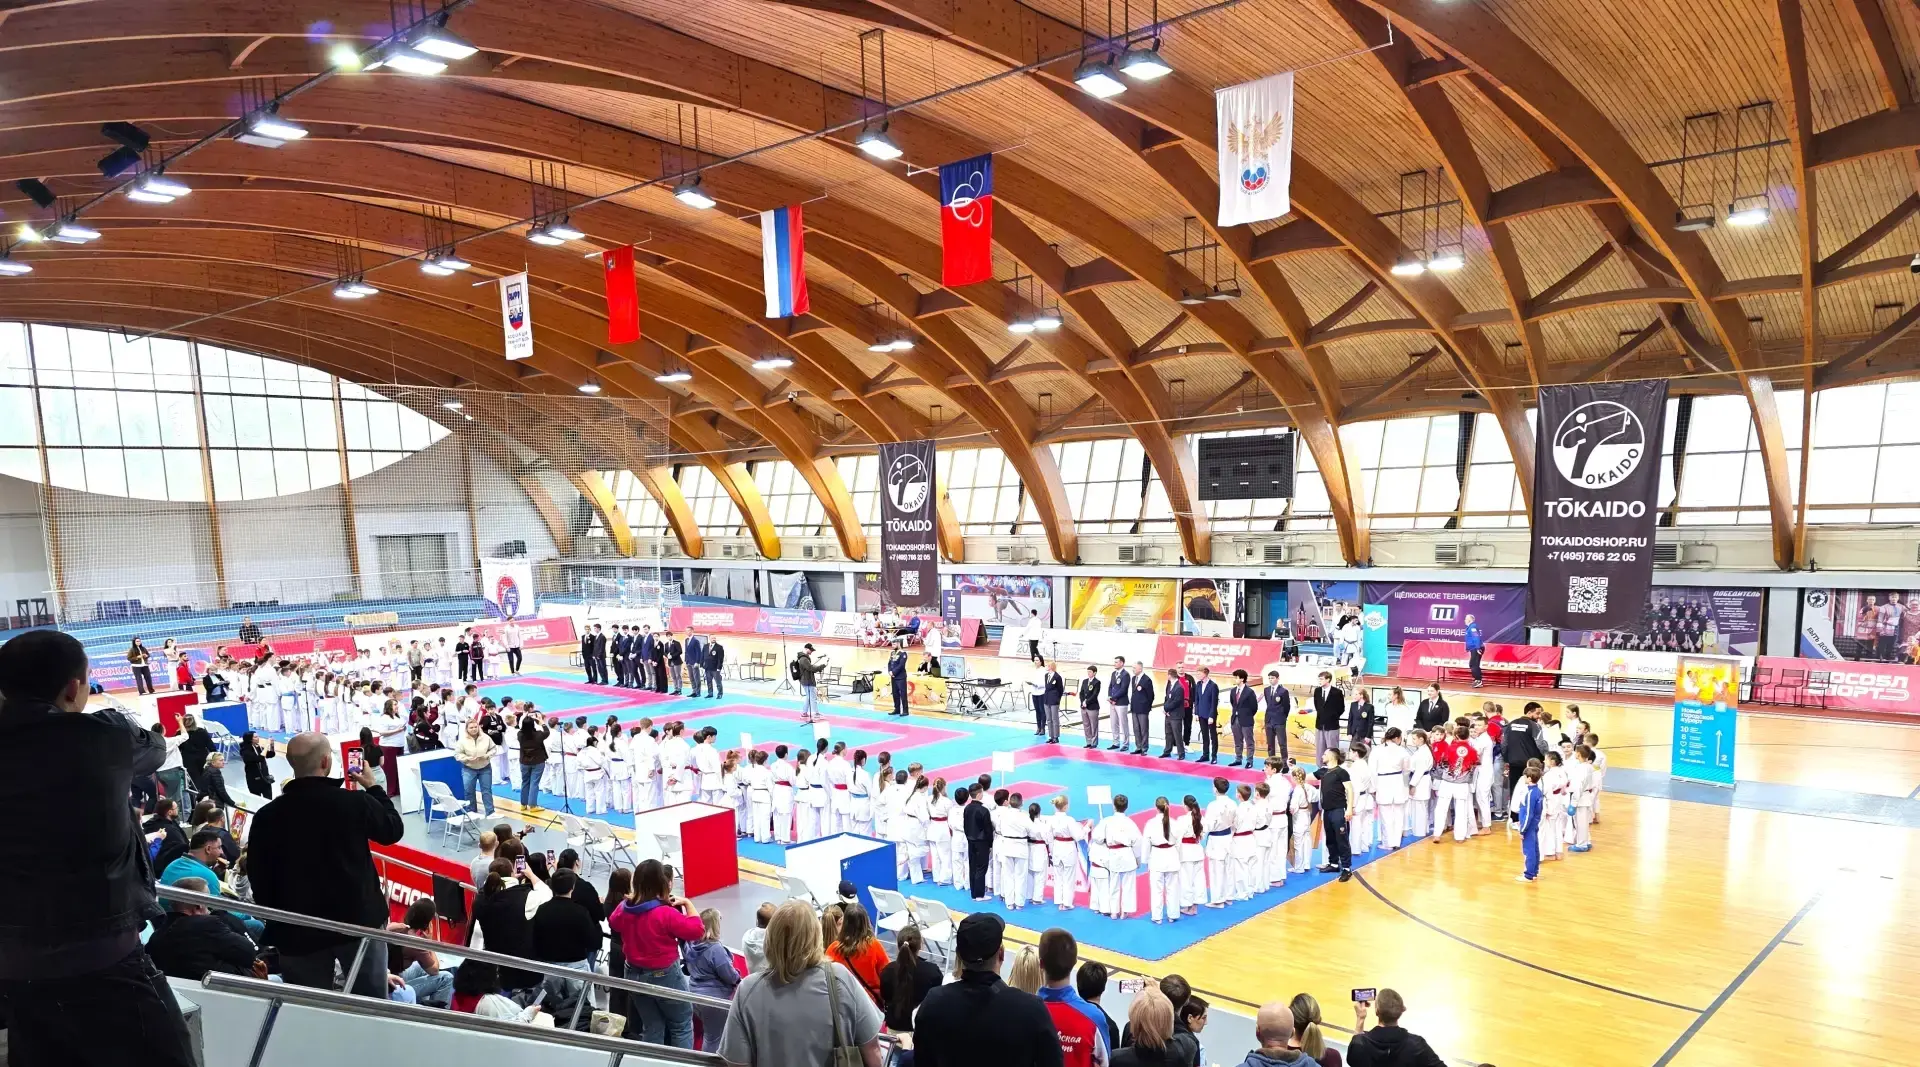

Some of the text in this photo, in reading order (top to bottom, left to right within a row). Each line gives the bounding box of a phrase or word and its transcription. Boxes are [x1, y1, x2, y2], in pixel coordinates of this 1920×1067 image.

[1544, 497, 1646, 518] TŌKAIDO
[1541, 536, 1647, 547] TOKAIDOSHOP.RU
[1547, 552, 1636, 562] +7 (495) 766 22 05
[1394, 591, 1495, 601] ЩЁЛКОВСКОЕ ТЕЛЕВИДЕНИЕ
[1404, 626, 1482, 637] ВАШЕ ТЕЛЕВИДЕ
[1186, 642, 1251, 657] МОСОБЛ
[1183, 653, 1235, 668] СПОРТ
[1637, 665, 1677, 675] КОМАНД
[1680, 725, 1689, 733] 10
